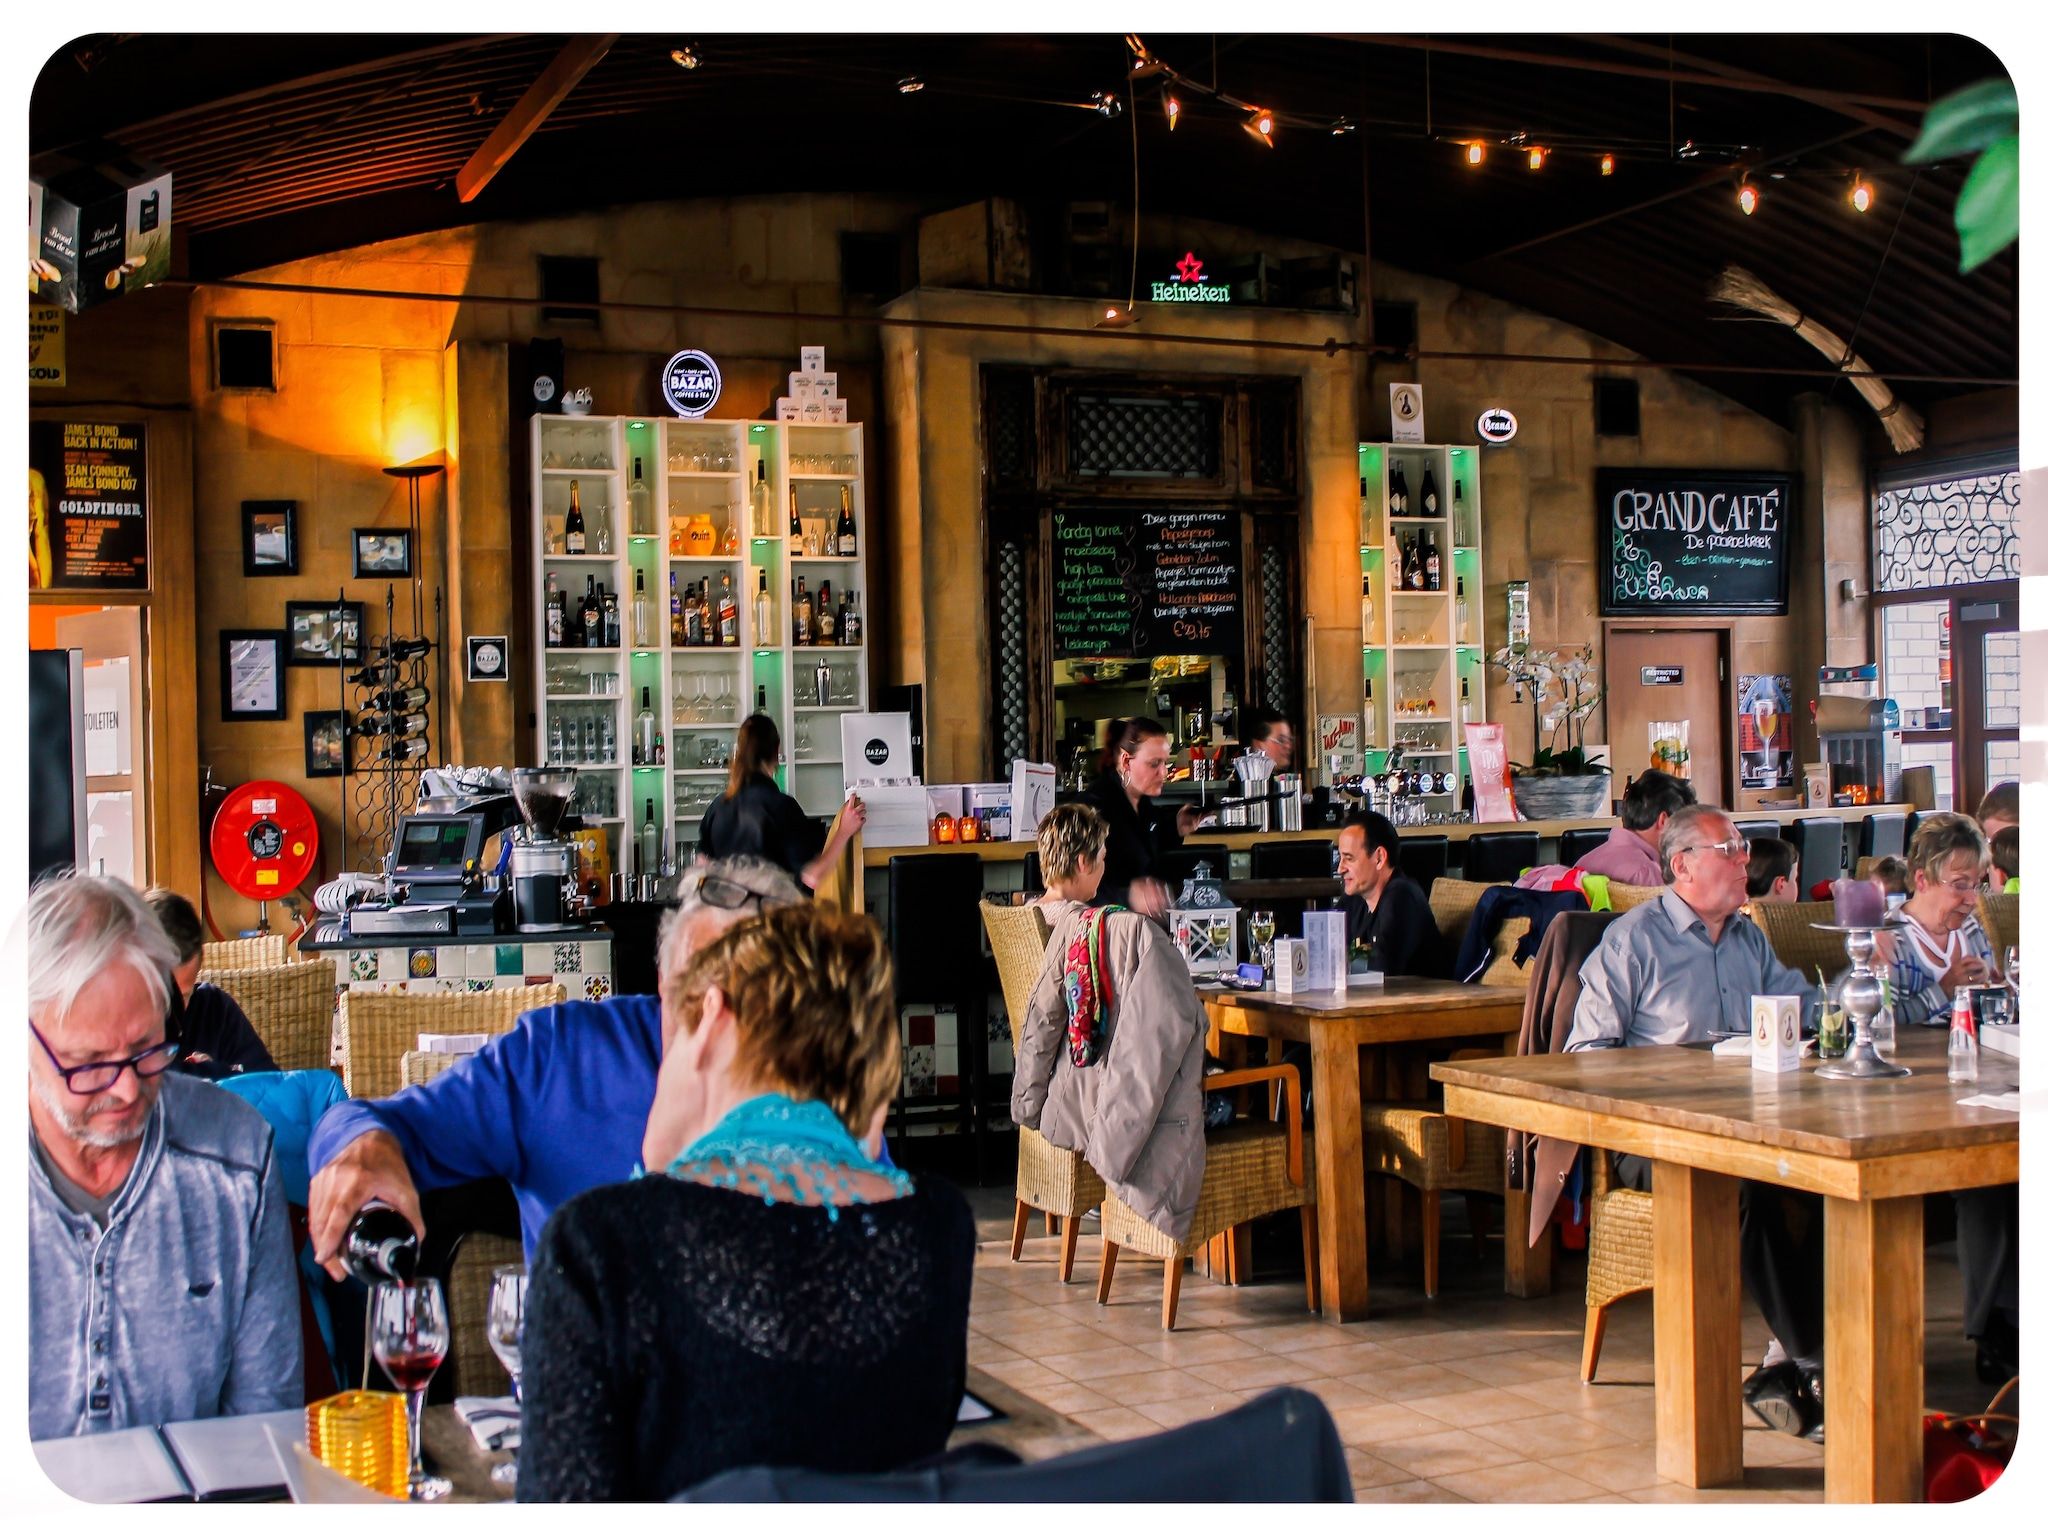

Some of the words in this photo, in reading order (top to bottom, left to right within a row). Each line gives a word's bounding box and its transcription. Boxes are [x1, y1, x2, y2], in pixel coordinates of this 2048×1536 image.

[1151, 282, 1230, 303] Heineken
[670, 376, 714, 390] BAZAR
[674, 391, 695, 399] COFFEE
[699, 391, 710, 399] TEA
[64, 424, 93, 436] JAMES
[94, 425, 119, 437] BOND
[1484, 418, 1512, 432] Brand
[64, 436, 88, 448] BACK
[90, 437, 100, 448] IN
[65, 464, 88, 476] SEAN
[65, 476, 95, 488] JAMES
[96, 478, 120, 489] BOND
[121, 479, 138, 491] 007
[1614, 488, 1706, 532] GRAND
[1708, 488, 1780, 534] CAFÉ
[1683, 534, 1704, 549] De
[84, 711, 119, 731] TOILETTEN
[865, 748, 888, 757] BAZAR
